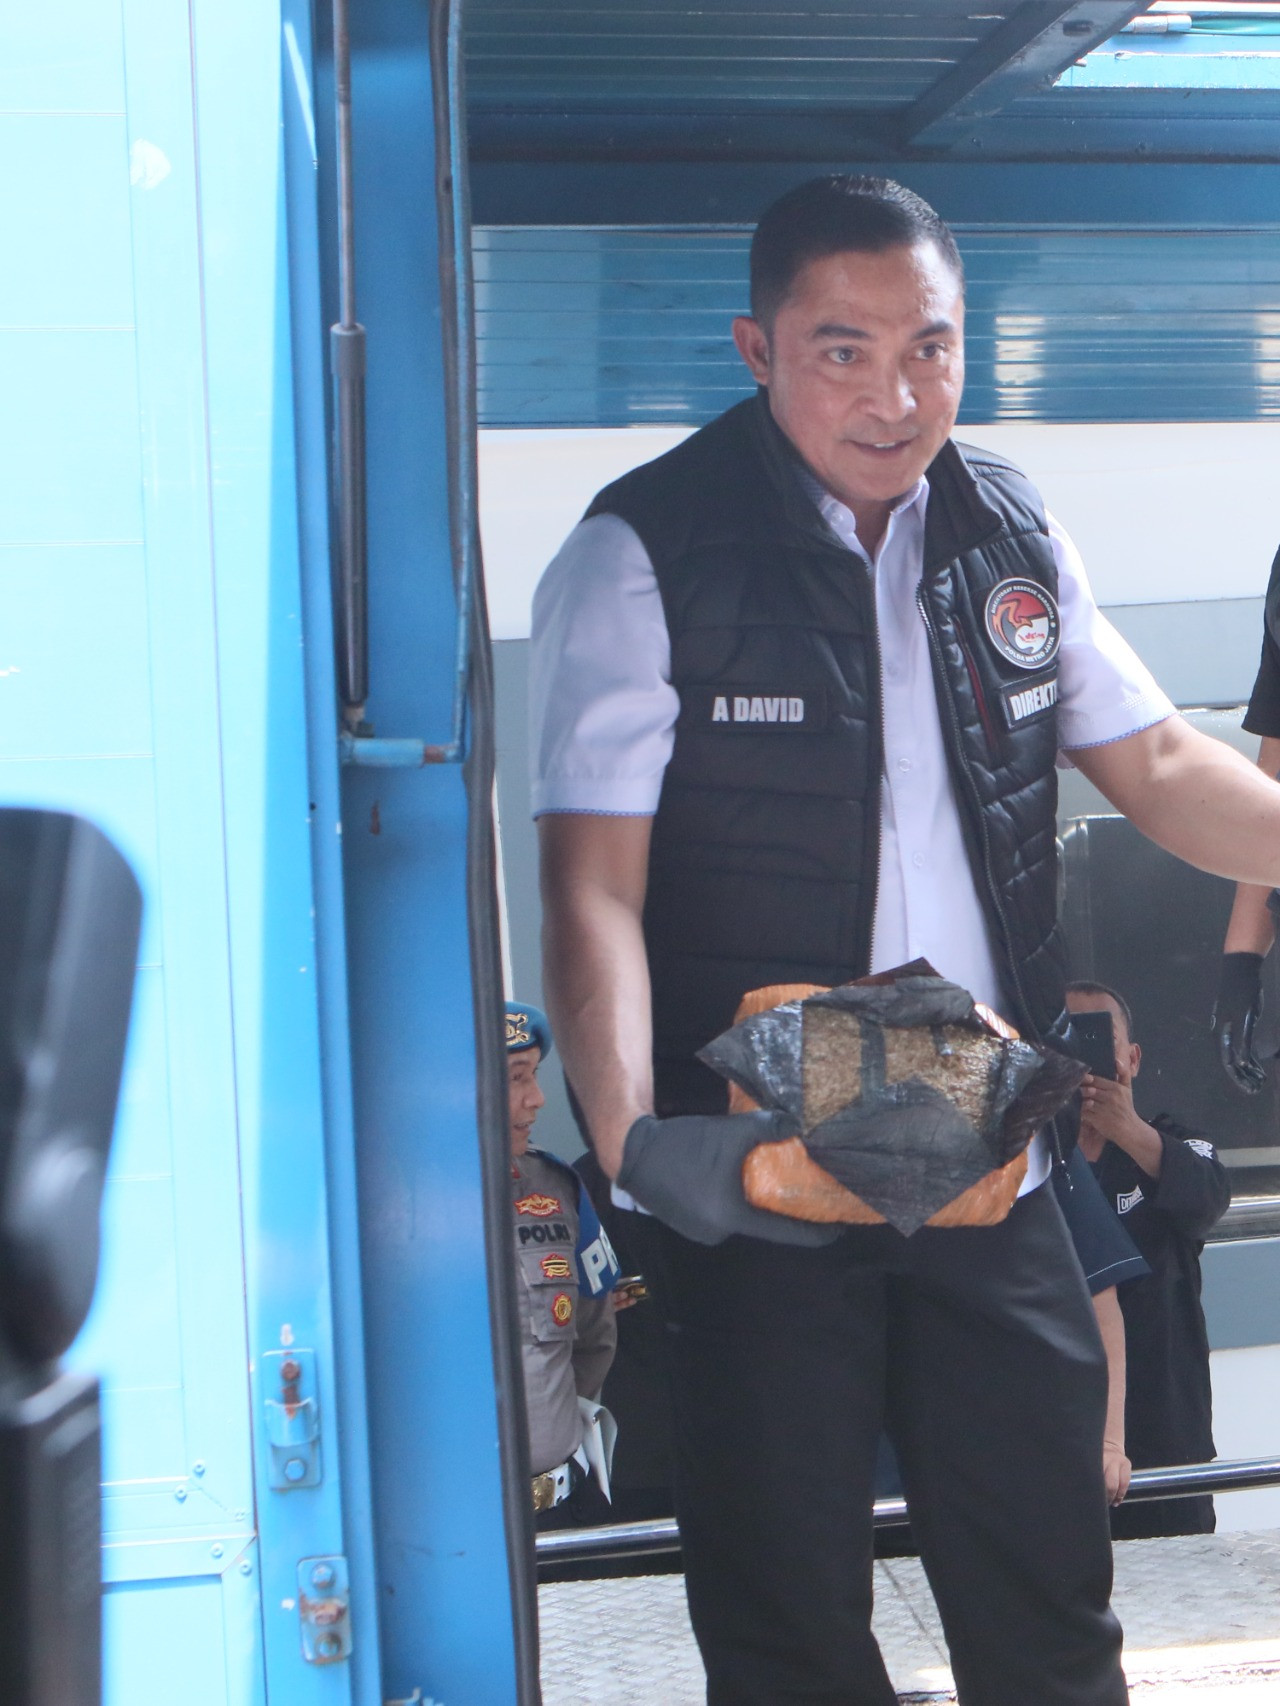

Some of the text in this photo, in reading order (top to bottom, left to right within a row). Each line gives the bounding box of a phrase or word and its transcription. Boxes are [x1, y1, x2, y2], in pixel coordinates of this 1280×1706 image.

[1004, 645, 1025, 662] POLDA
[1025, 650, 1046, 663] METRO
[1045, 636, 1055, 653] JAYA
[712, 696, 805, 723] A DAVID
[518, 1223, 571, 1245] POLRI
